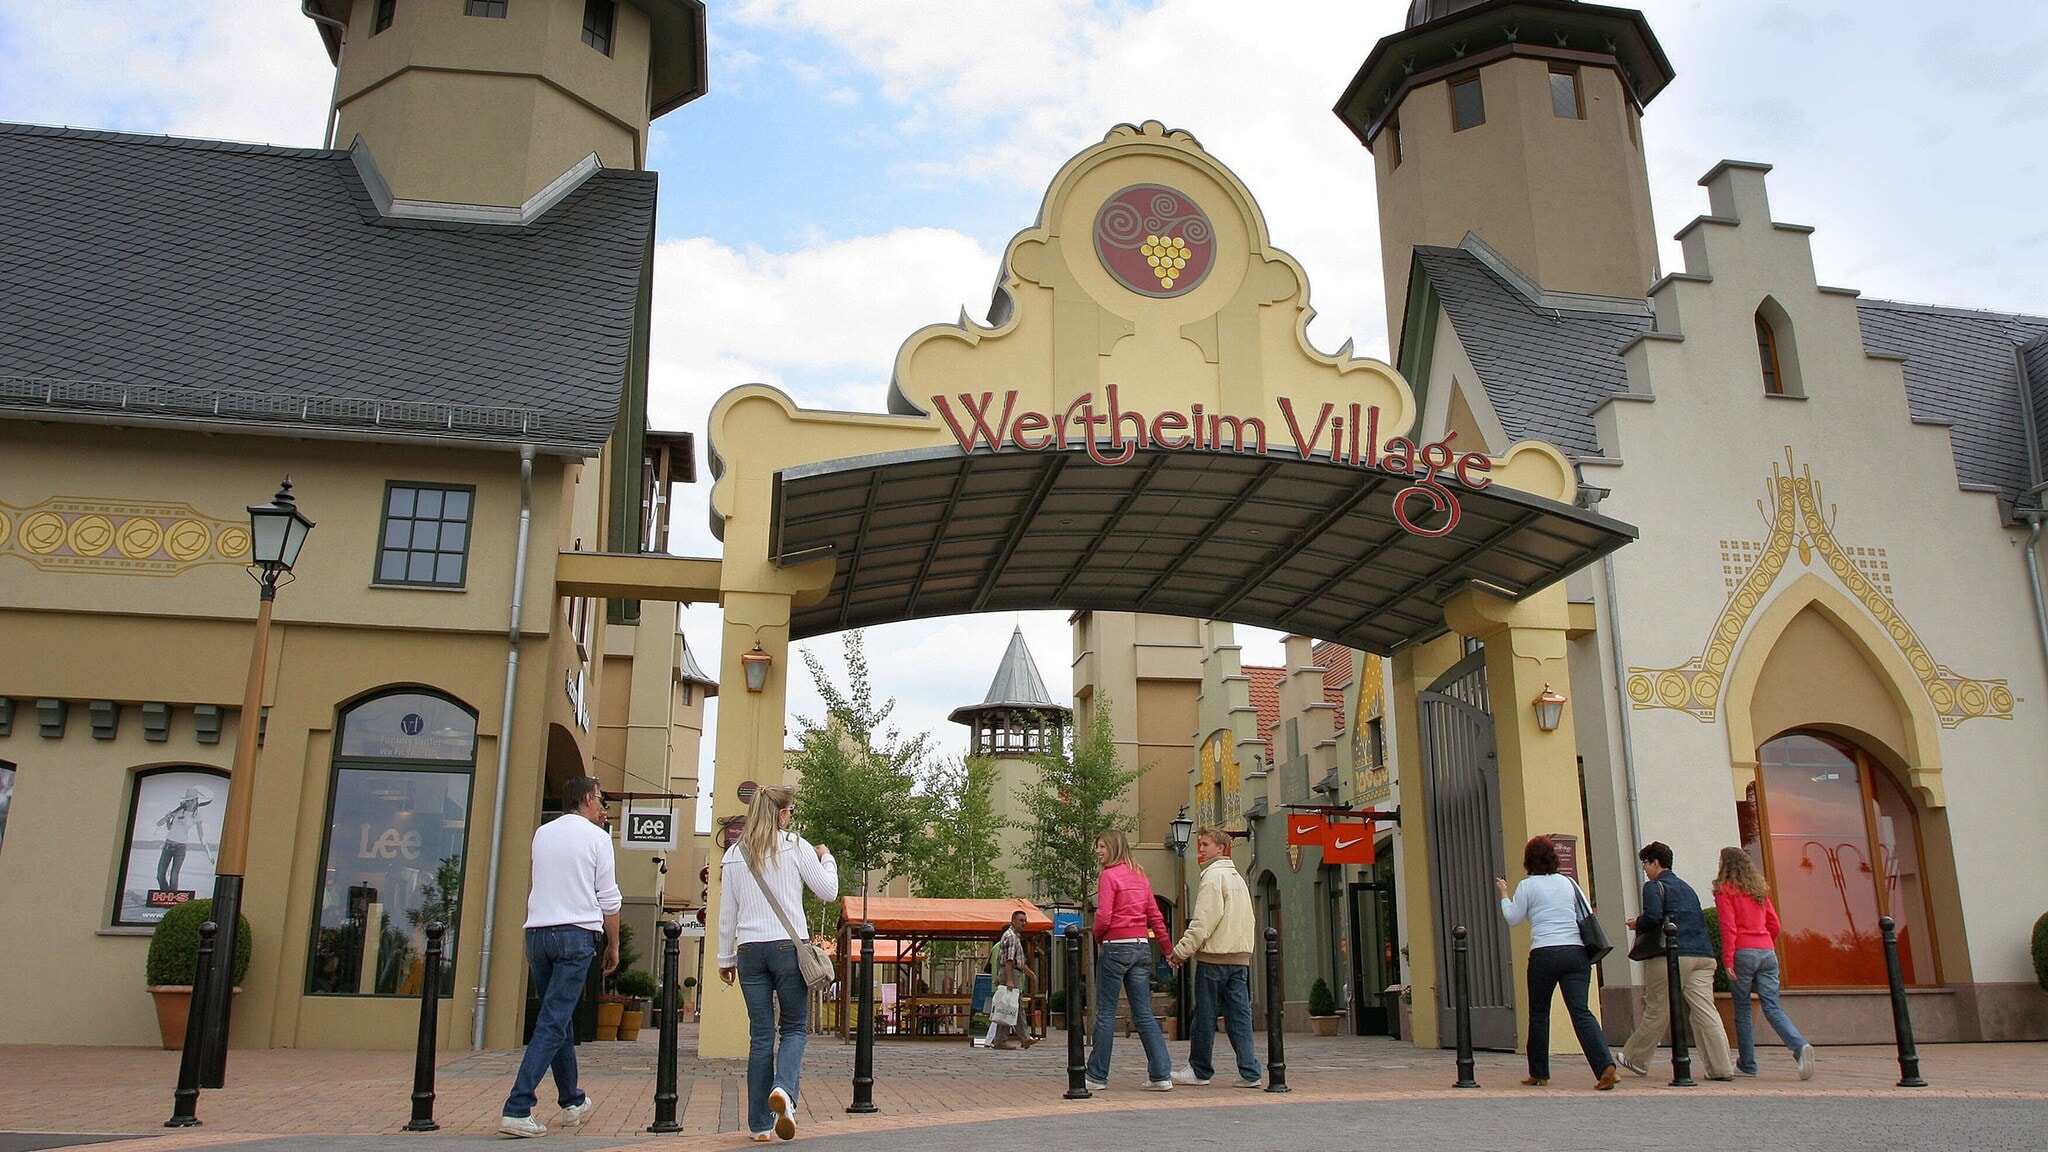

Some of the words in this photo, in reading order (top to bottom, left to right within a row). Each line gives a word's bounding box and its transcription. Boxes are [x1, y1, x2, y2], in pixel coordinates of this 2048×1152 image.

[931, 384, 1268, 466] Wertheim
[1277, 396, 1492, 537] Village
[358, 823, 421, 860] Lee
[633, 817, 664, 835] Lee
